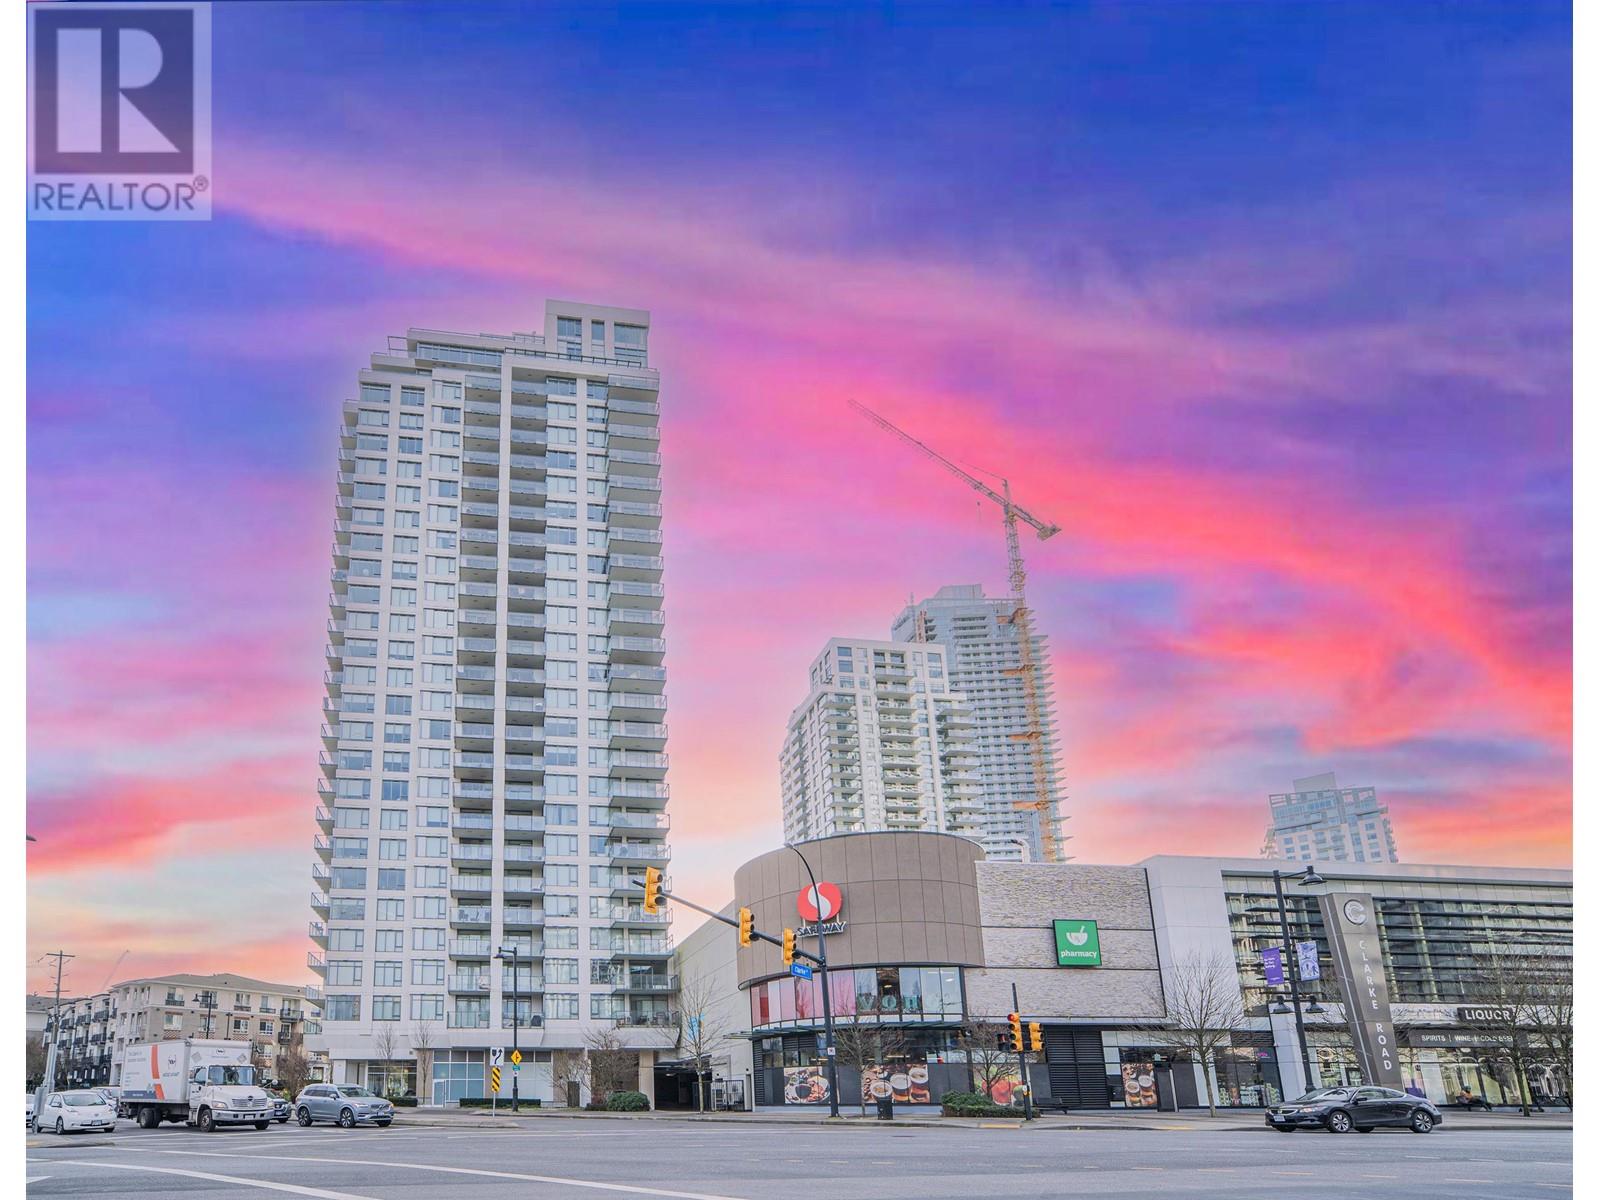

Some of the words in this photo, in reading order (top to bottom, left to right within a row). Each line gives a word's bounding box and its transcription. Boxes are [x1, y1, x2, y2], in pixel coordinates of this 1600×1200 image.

[796, 920, 847, 938] SAFWAY
[1060, 949, 1097, 959] pharmacy
[1359, 940, 1379, 1010] CLARKE
[1376, 1022, 1392, 1070] ROAD
[1421, 1034, 1446, 1042] SPIRITS
